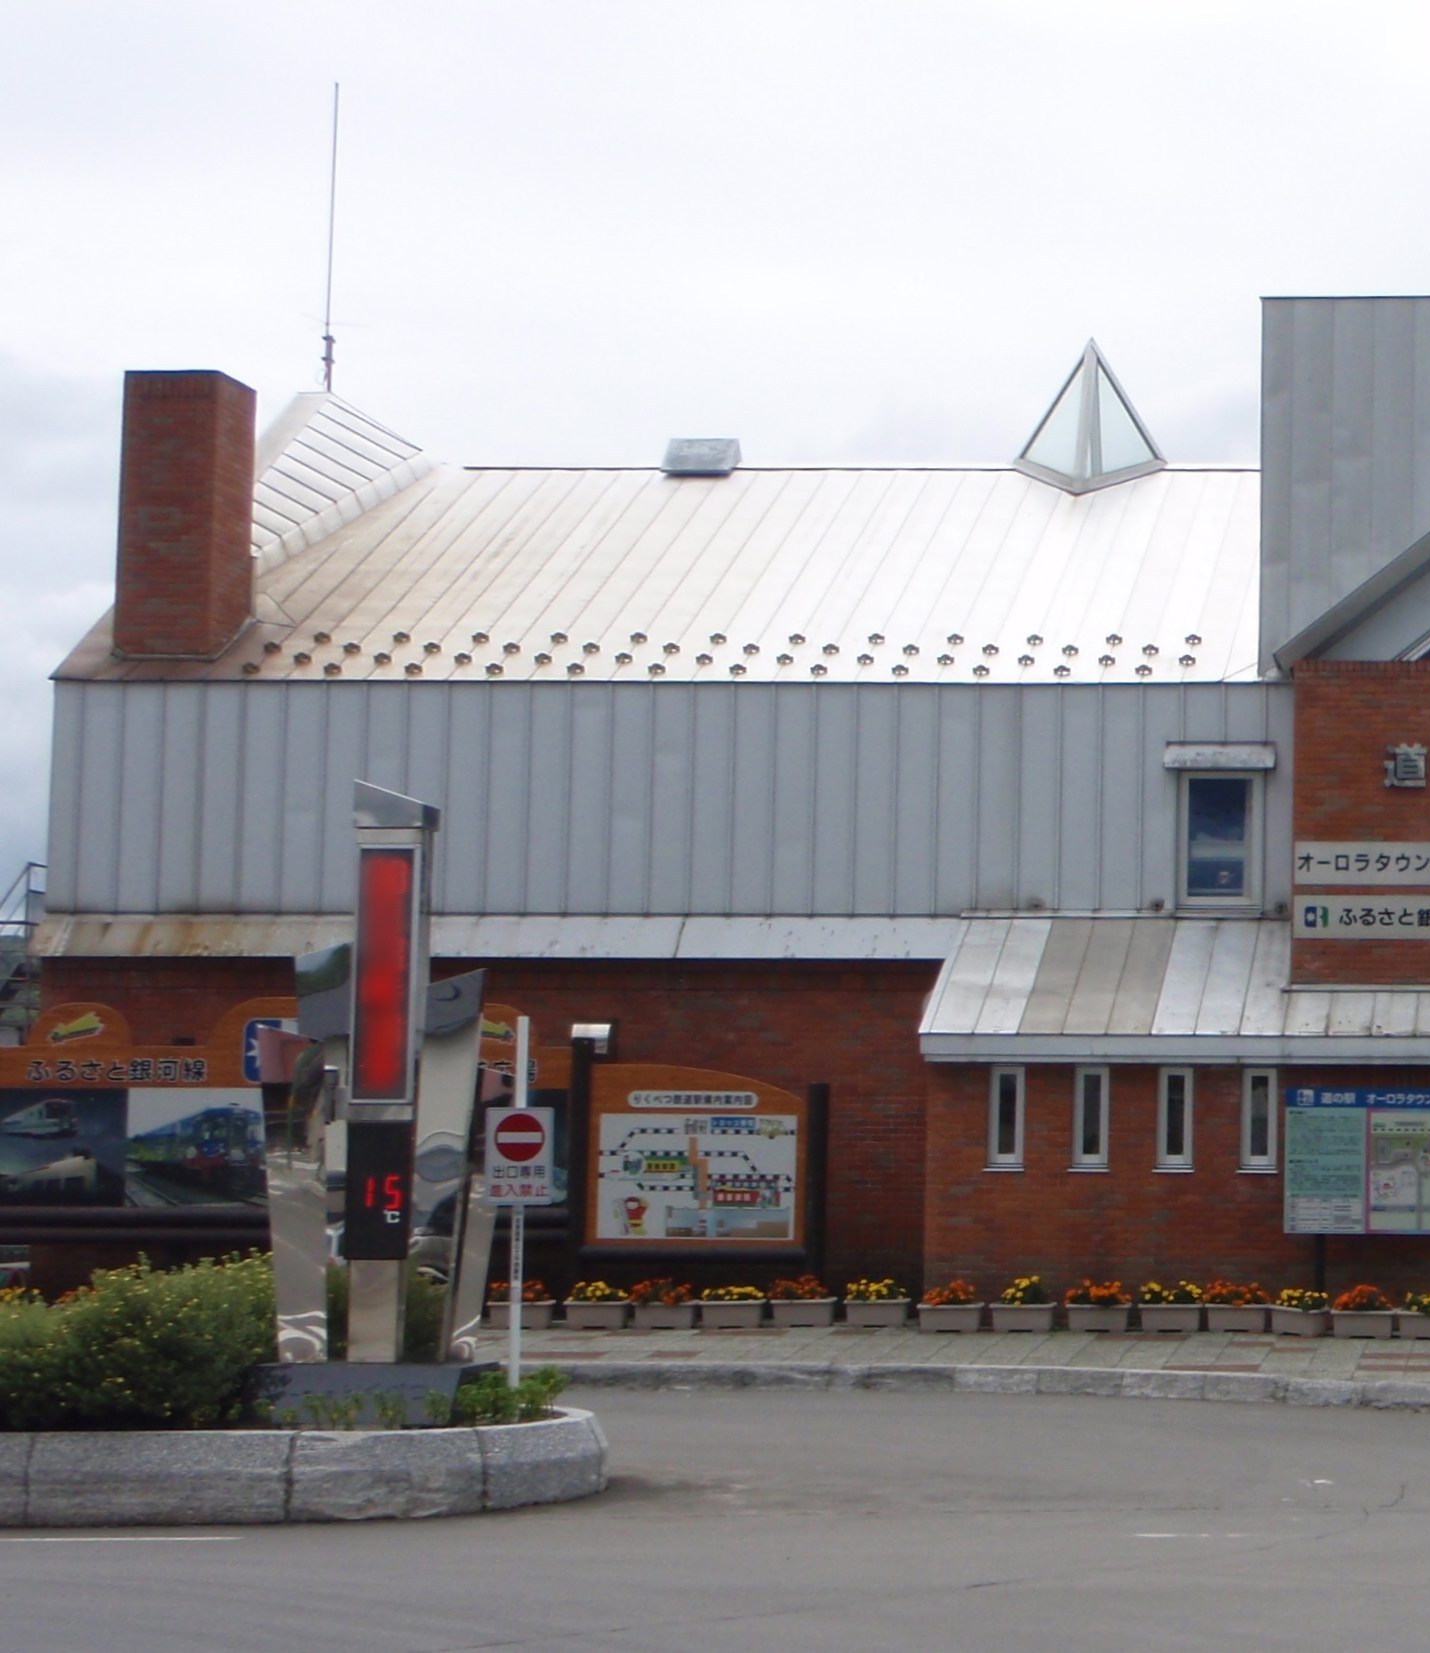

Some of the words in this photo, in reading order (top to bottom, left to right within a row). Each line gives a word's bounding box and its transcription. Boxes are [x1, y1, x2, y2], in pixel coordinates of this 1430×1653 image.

[27, 1058, 208, 1083] ふるさと銀河線
[364, 1173, 404, 1209] 15
